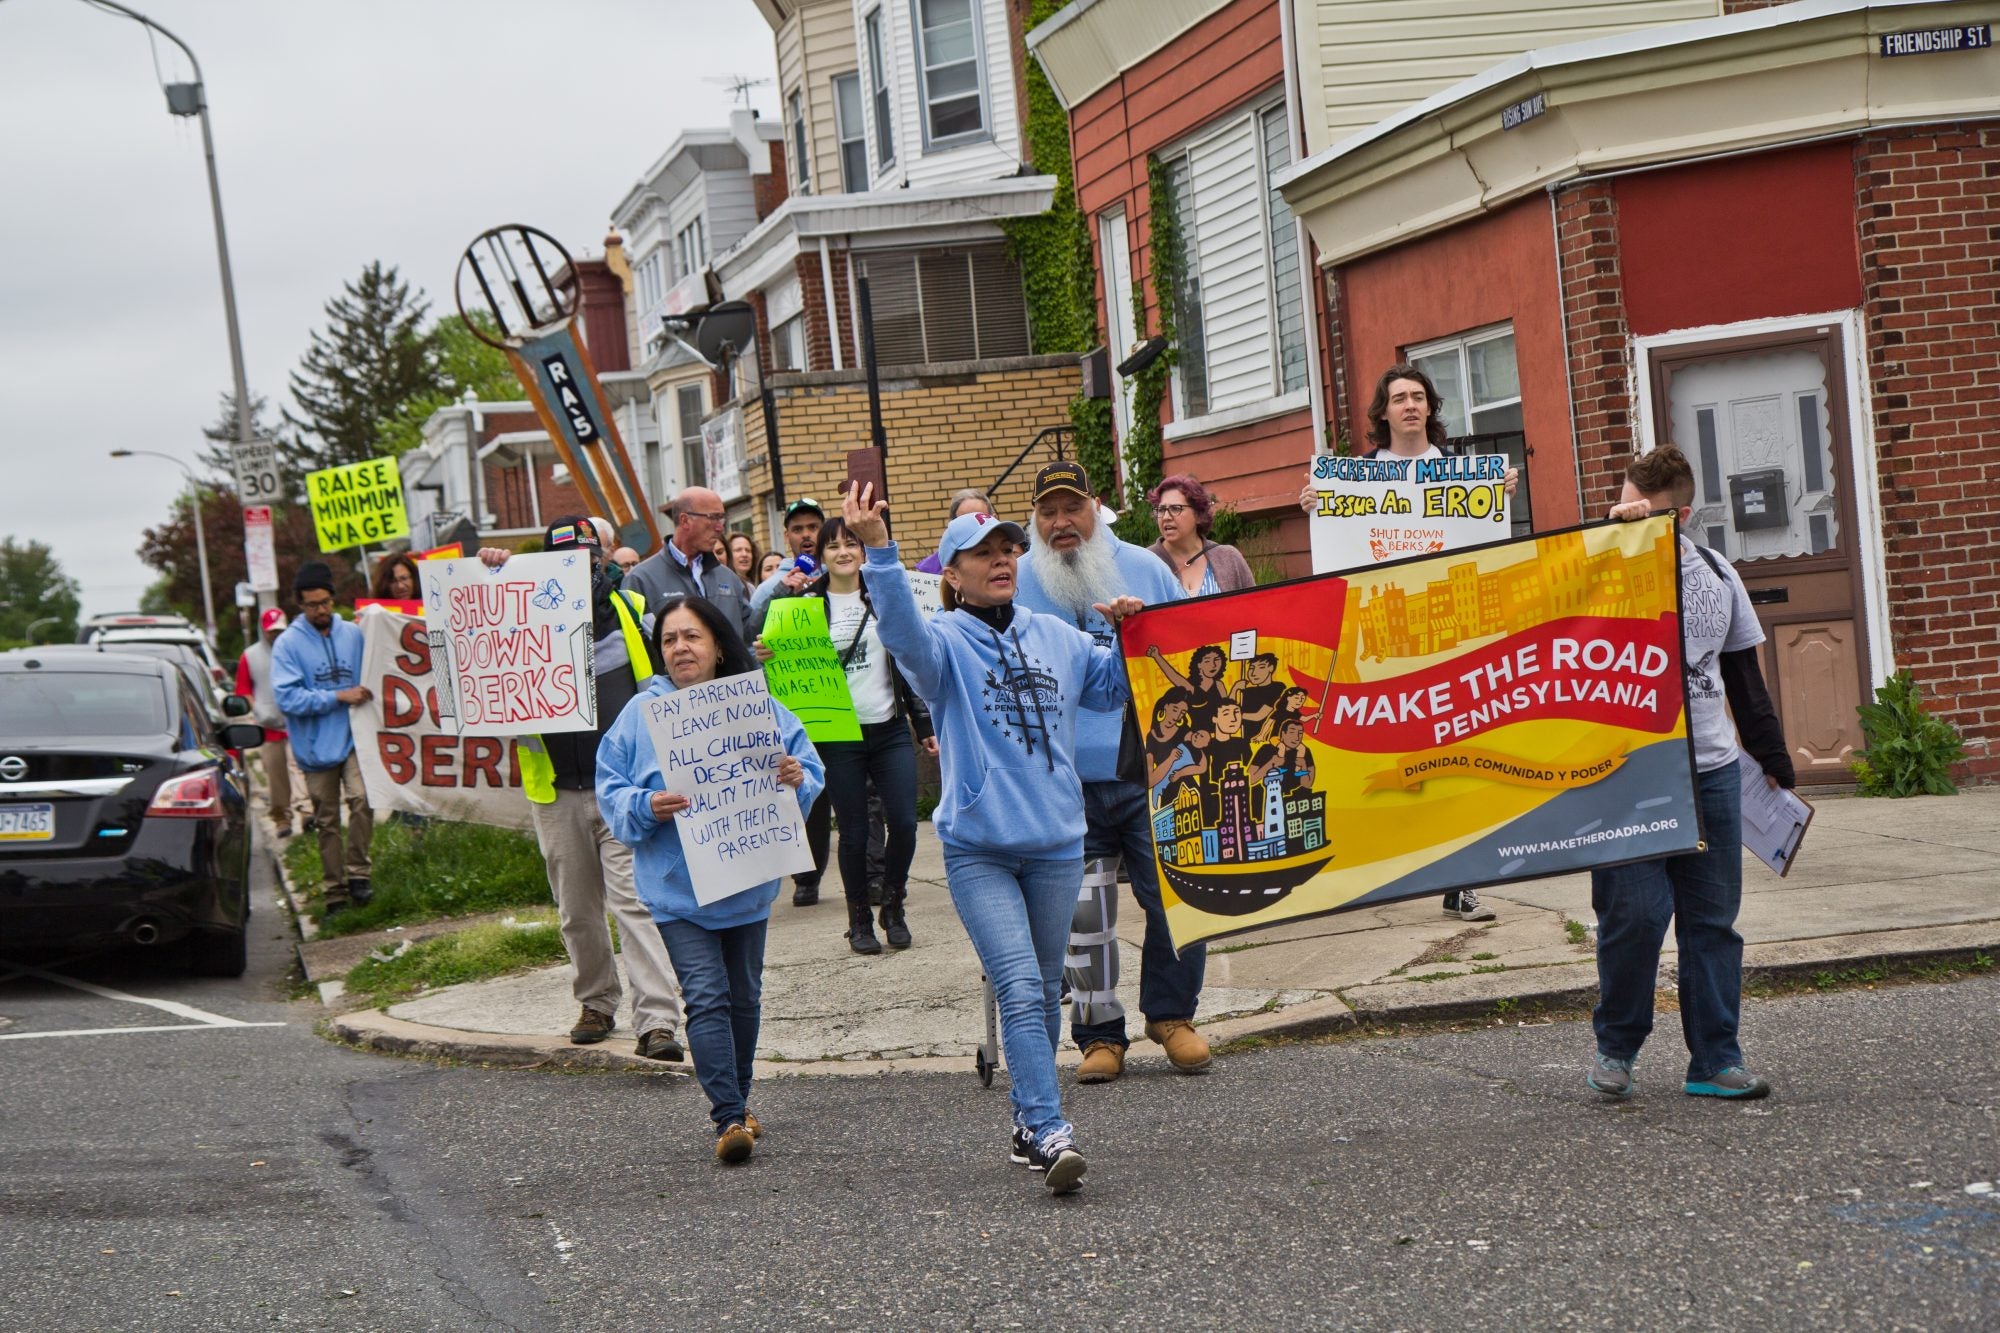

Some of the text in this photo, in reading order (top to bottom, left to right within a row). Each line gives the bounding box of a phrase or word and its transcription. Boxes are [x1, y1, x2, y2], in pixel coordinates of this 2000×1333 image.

[1886, 26, 1987, 54] FRIENDSHIP ST.
[1503, 105, 1521, 129] RISING
[1521, 100, 1533, 120] SUN
[235, 445, 271, 459] SPEED
[241, 458, 269, 472] LIMIT
[242, 472, 276, 497] 30
[317, 463, 388, 497] RAISE
[1314, 456, 1505, 484] SECRETARY MILLER
[316, 486, 400, 522] MINIMUM
[1316, 484, 1505, 522] Issue An ERO!
[321, 513, 397, 545] WAGE
[1370, 528, 1444, 540] SHUT DOWN
[1388, 541, 1424, 551] BERKS
[449, 582, 535, 632] SHUT
[792, 607, 811, 631] PA
[454, 624, 551, 672] DOWN
[768, 660, 796, 676] THE
[795, 656, 841, 672] MINIMUM
[1034, 676, 1056, 688] ROAD
[1333, 637, 1669, 726] MAKE THE ROAD
[459, 664, 577, 725] BERKS
[650, 678, 765, 722] PAY PARENTAL
[995, 704, 1058, 712] PENNSYLANIA
[672, 698, 771, 740] LEAVE NOW!
[1433, 679, 1658, 744] PENNSYLVANIA
[669, 730, 781, 771] ALL CHILDREN
[693, 752, 783, 784] DESERVE
[1405, 756, 1613, 781] DIGNIDAD, COMUNIDAD Y PODER
[741, 774, 785, 799] TIME
[691, 803, 779, 845] WITH THEIR
[1498, 818, 1679, 858] WWW.MAKETHEROADPA.ORG
[717, 821, 800, 862] PARENTS!
